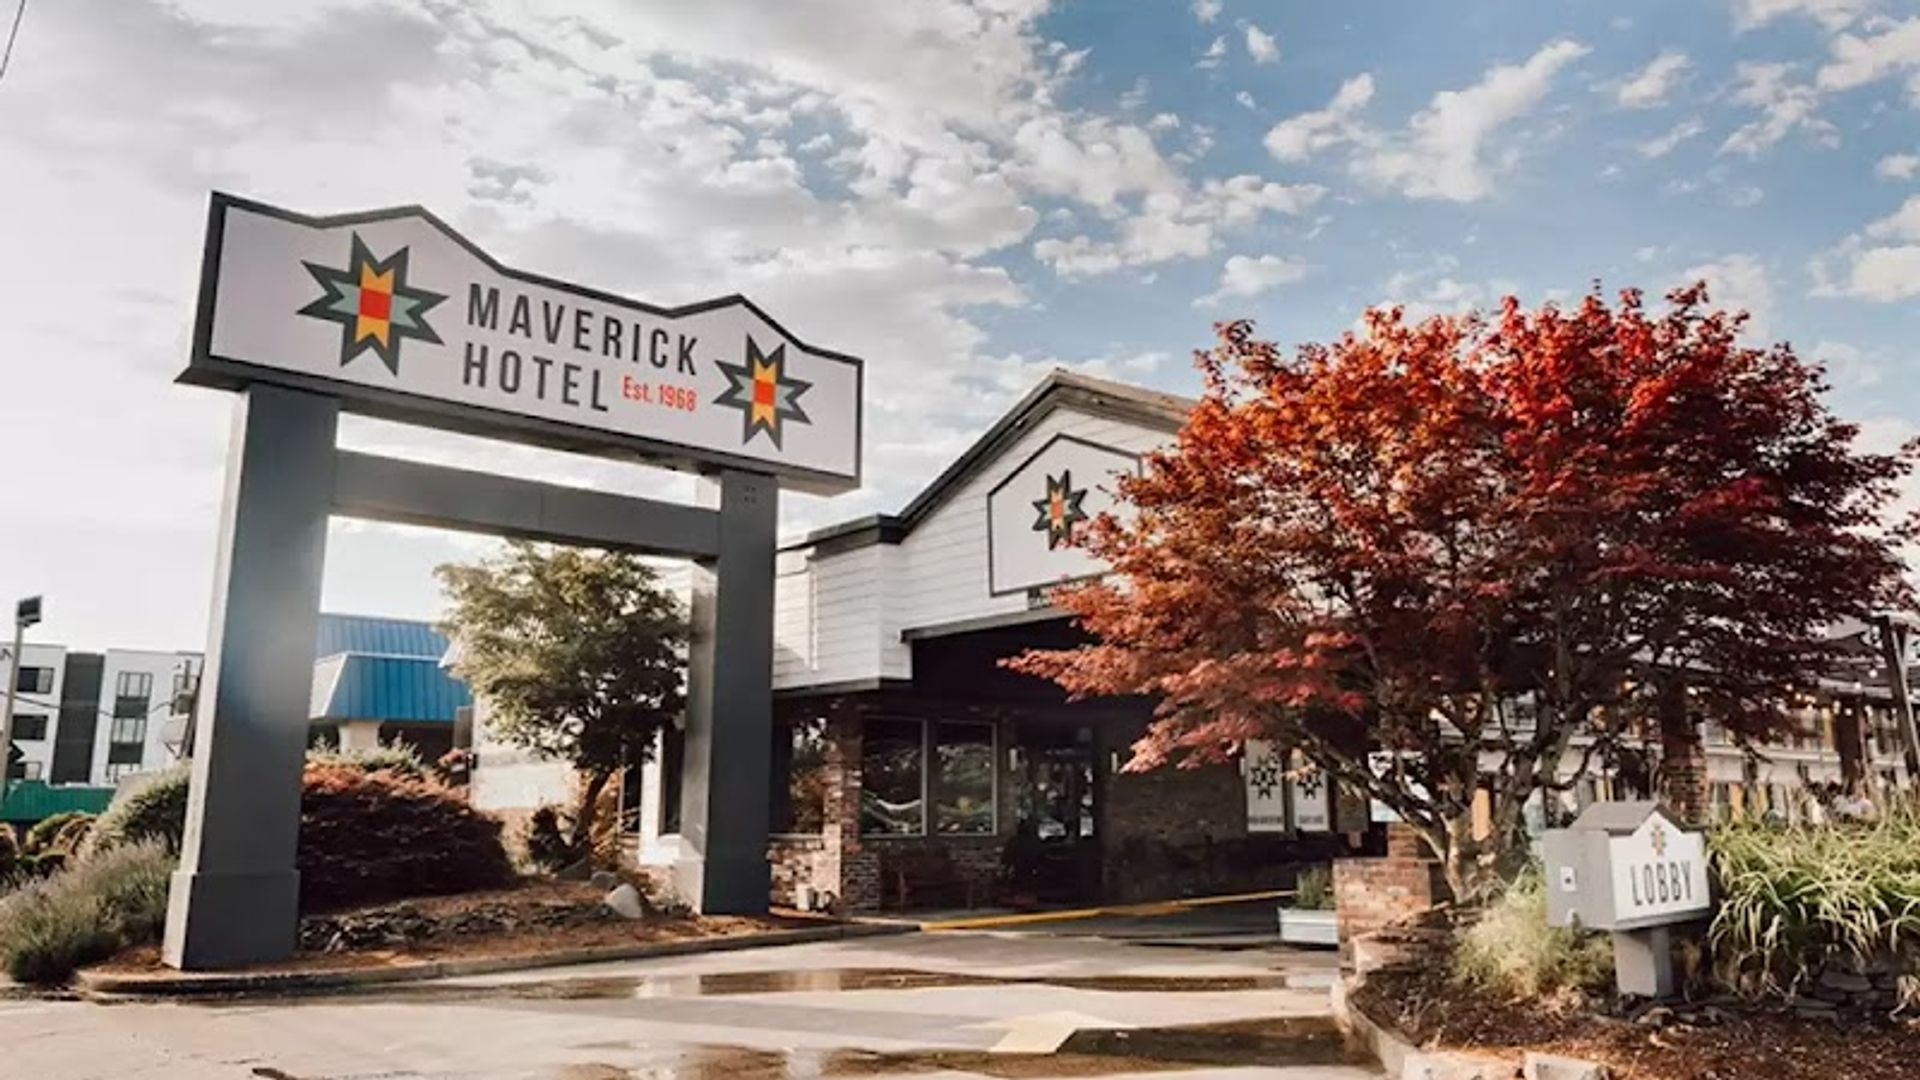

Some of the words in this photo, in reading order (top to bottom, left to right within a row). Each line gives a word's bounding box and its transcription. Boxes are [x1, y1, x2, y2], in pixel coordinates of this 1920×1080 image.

[467, 282, 697, 376] MAVERICK
[463, 341, 609, 412] HOTEL
[623, 375, 653, 403] Est.
[658, 383, 697, 413] 1968
[1630, 860, 1692, 907] LOBBY
